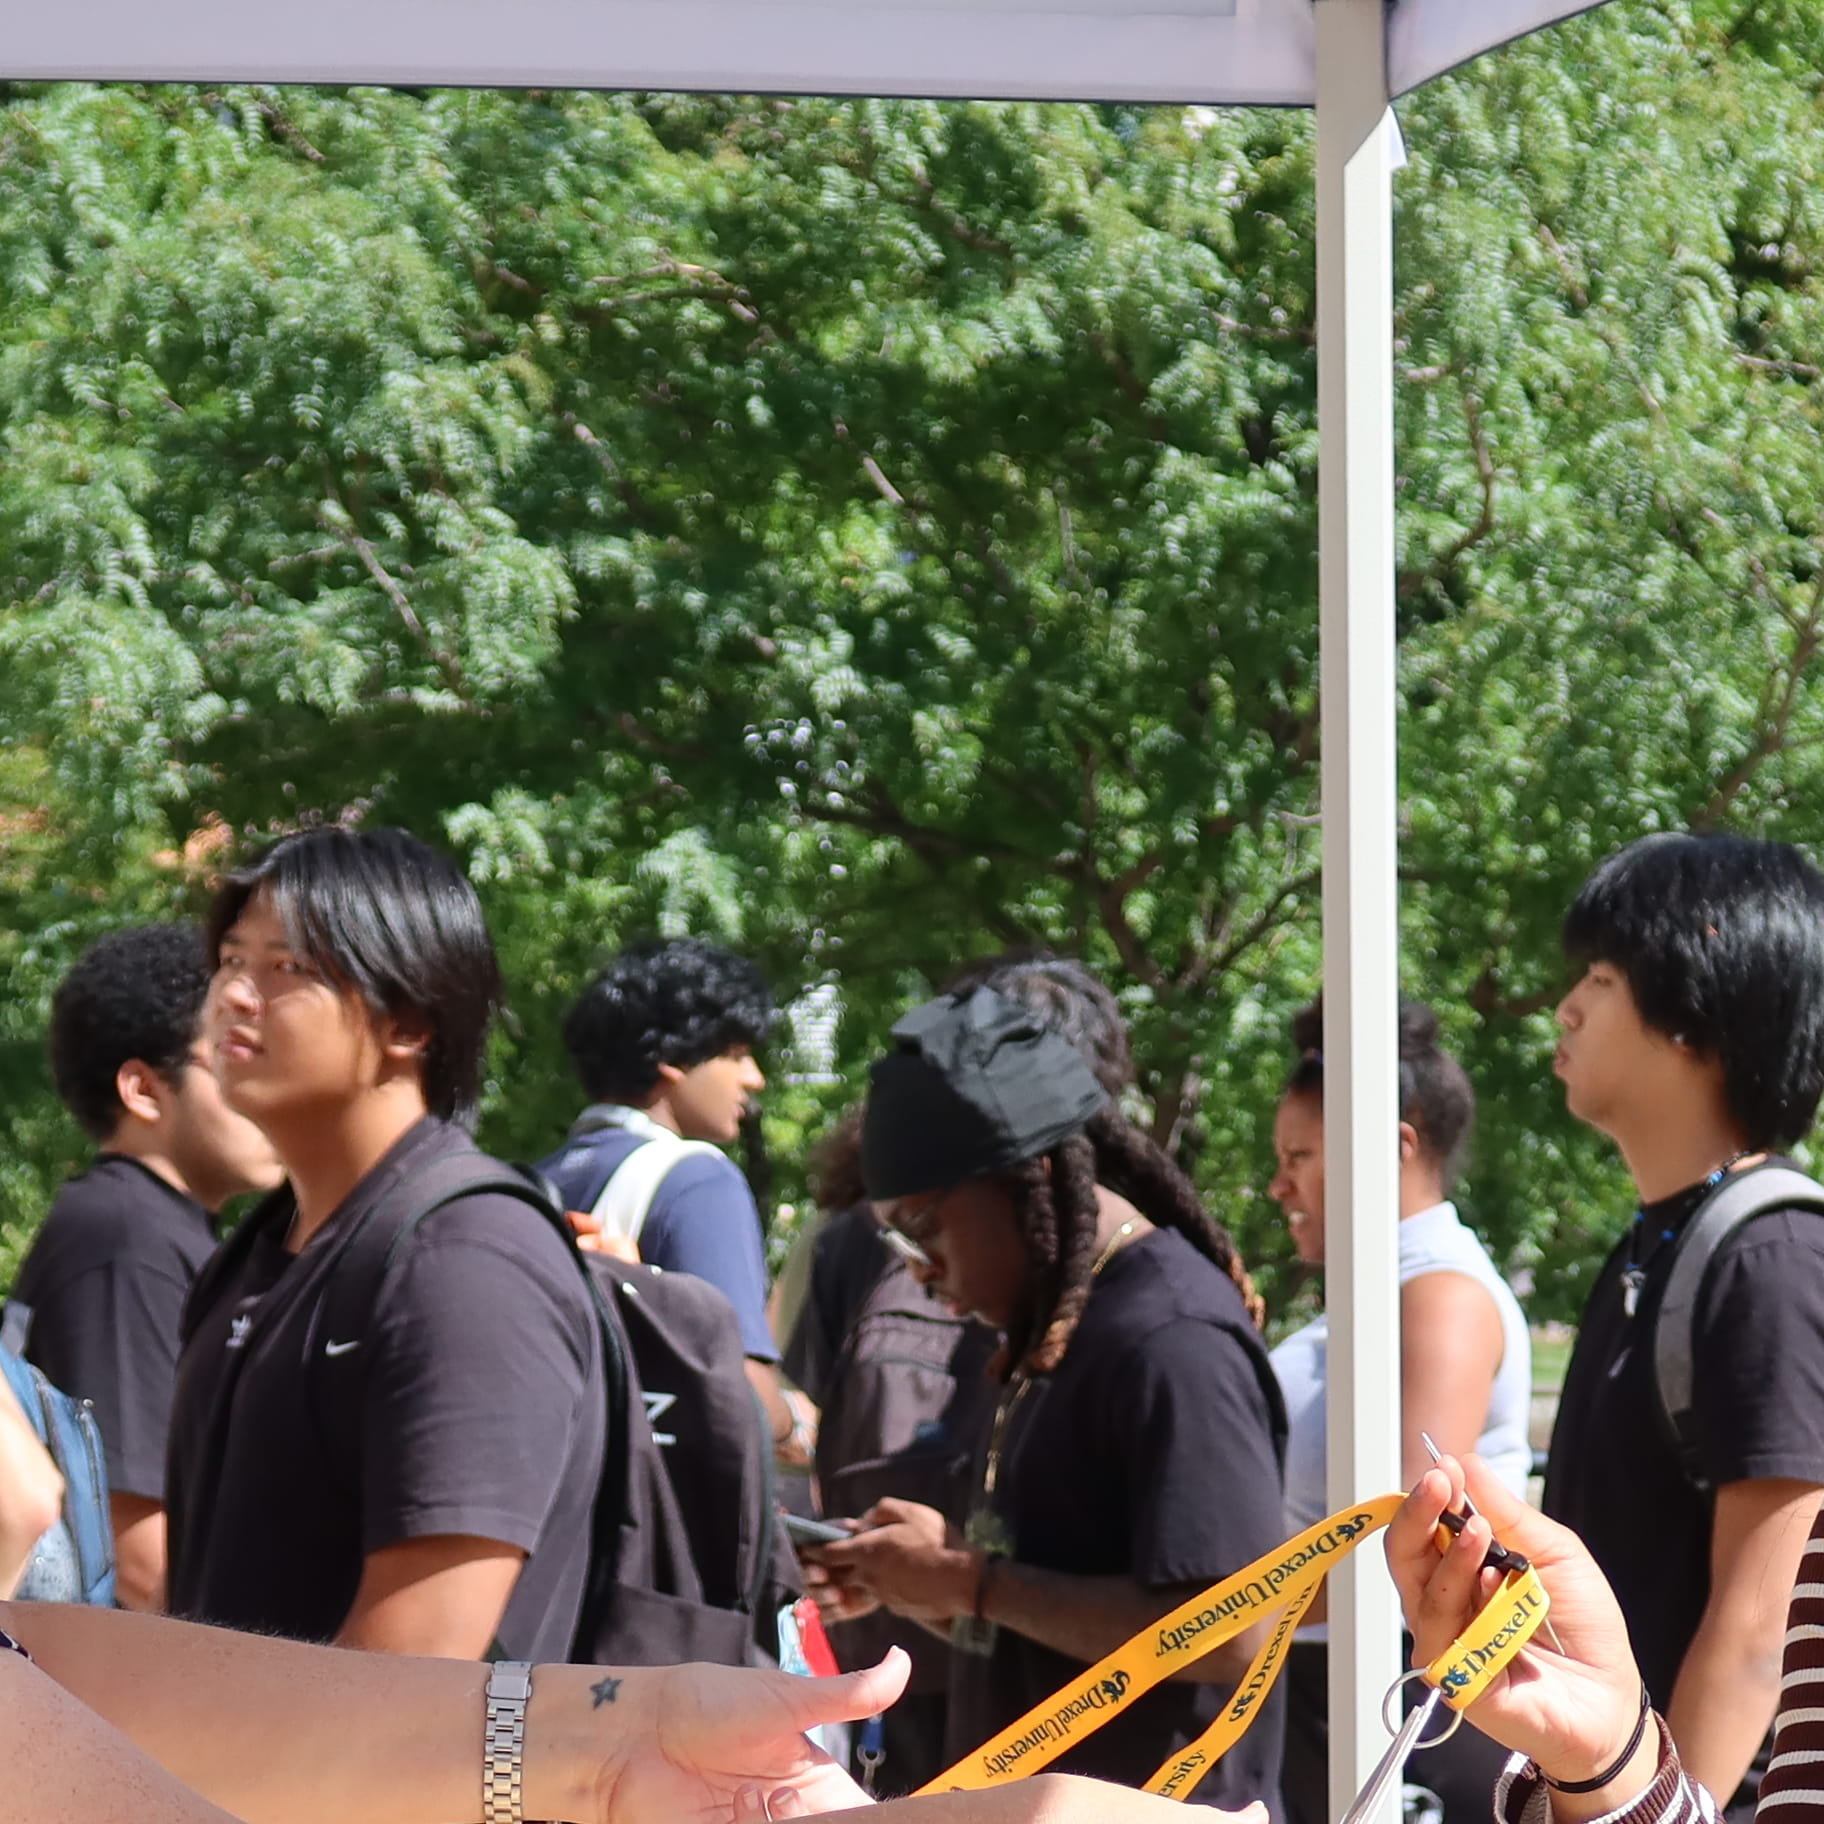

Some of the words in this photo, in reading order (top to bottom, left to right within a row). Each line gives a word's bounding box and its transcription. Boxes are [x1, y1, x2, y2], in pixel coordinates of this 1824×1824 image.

[1264, 1531, 1341, 1595] Drexel
[1156, 1582, 1271, 1657] University
[1463, 1600, 1531, 1675] Drexel
[1248, 1618, 1292, 1690] Drexel
[1055, 1682, 1108, 1733] Drexel
[983, 1718, 1065, 1777] University
[1157, 1750, 1206, 1797] ersity
